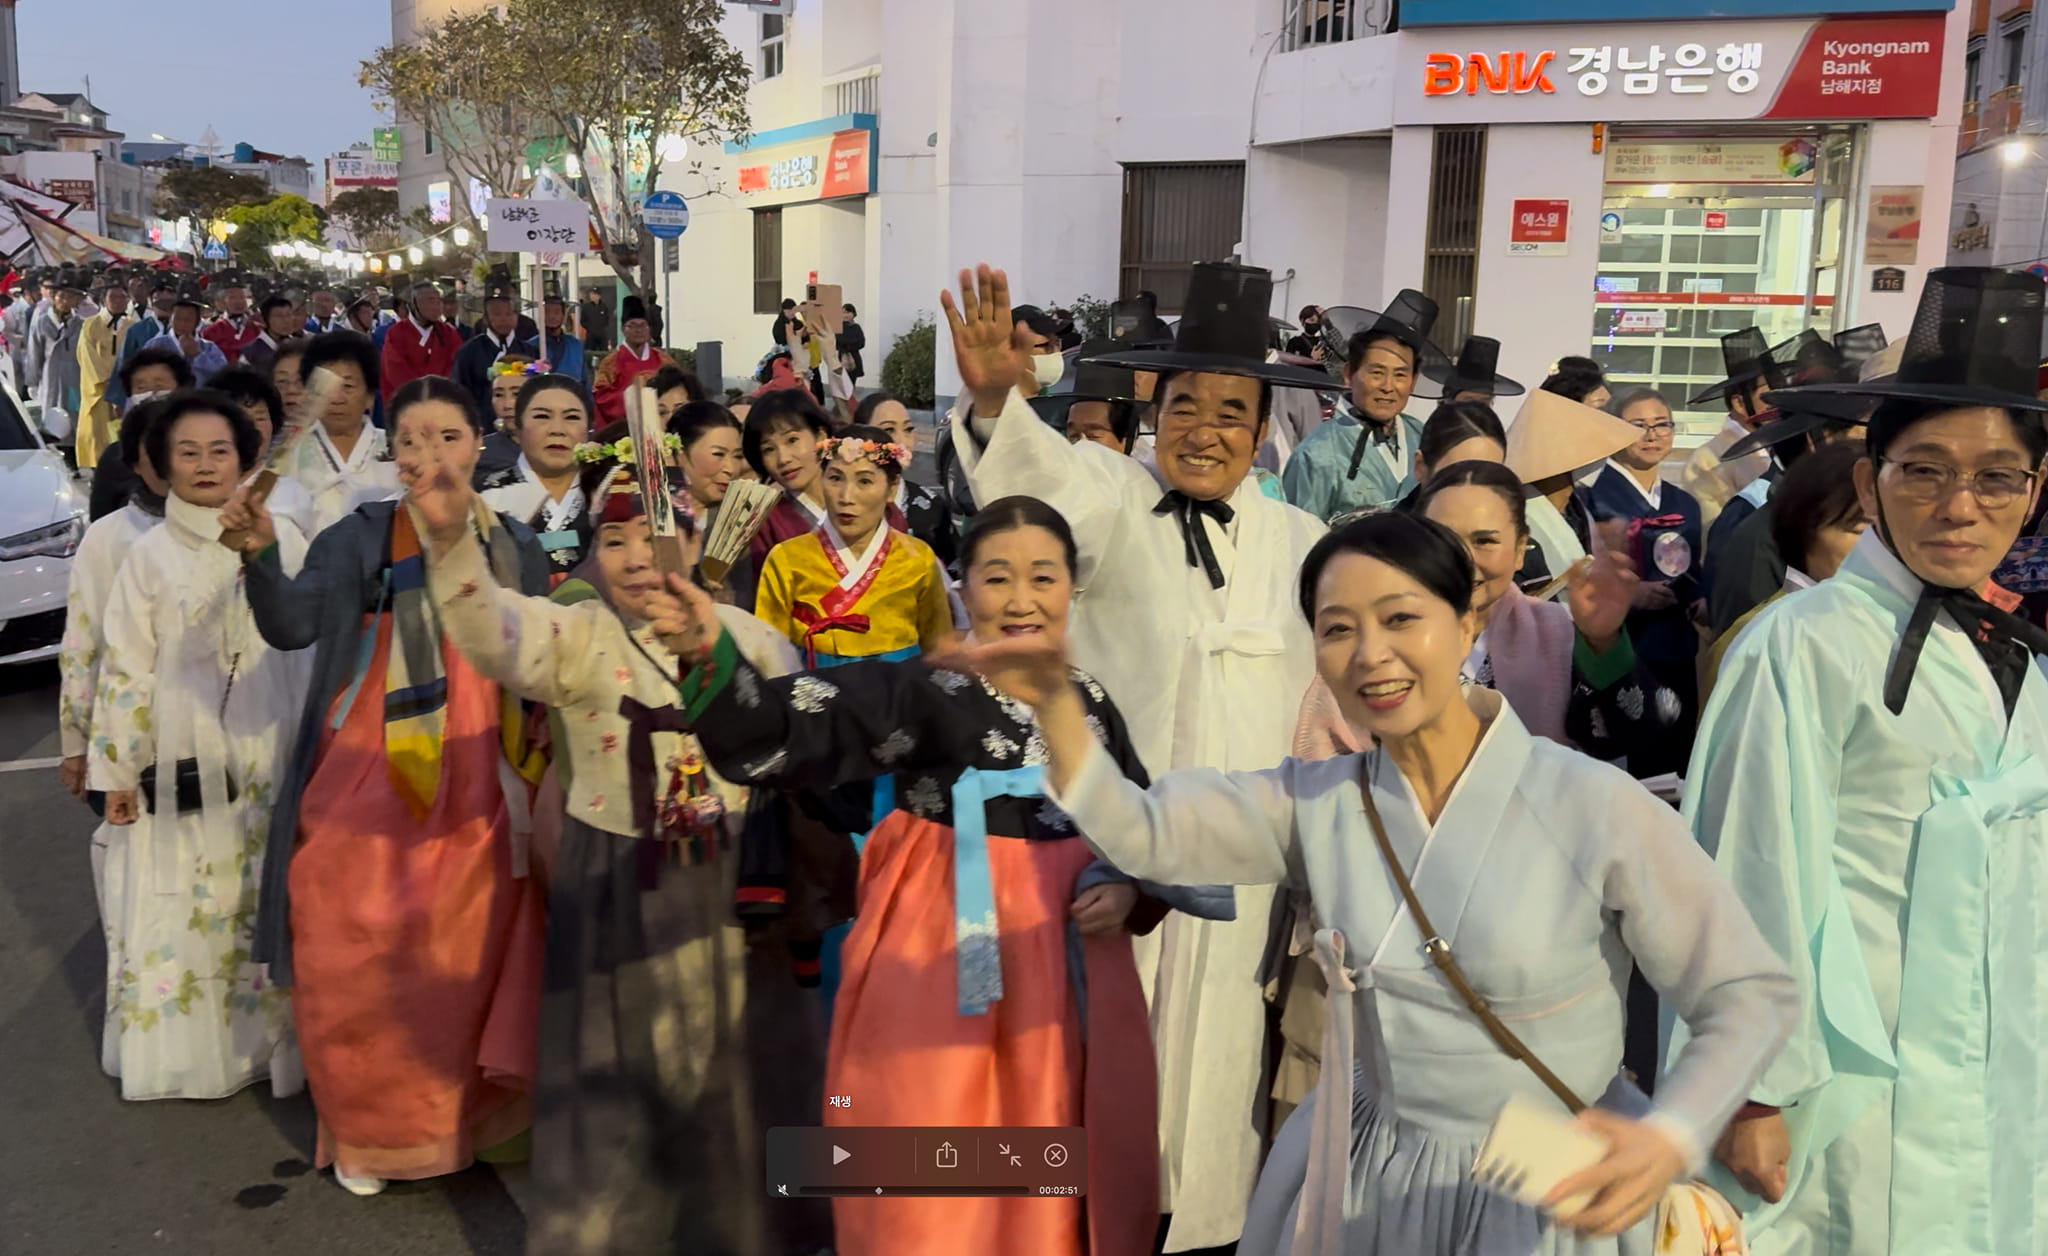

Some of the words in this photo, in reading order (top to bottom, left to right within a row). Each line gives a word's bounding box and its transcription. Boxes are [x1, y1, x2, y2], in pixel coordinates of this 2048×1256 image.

[1823, 40, 1930, 58] Kyongnam
[1424, 50, 1557, 96] BNK
[1567, 42, 1763, 96] 경남은행
[1822, 59, 1872, 75] Bank
[1820, 78, 1882, 95] 남해지점
[1520, 212, 1560, 228] 에스원
[526, 225, 576, 244] 이장단
[1877, 279, 1900, 290] 116
